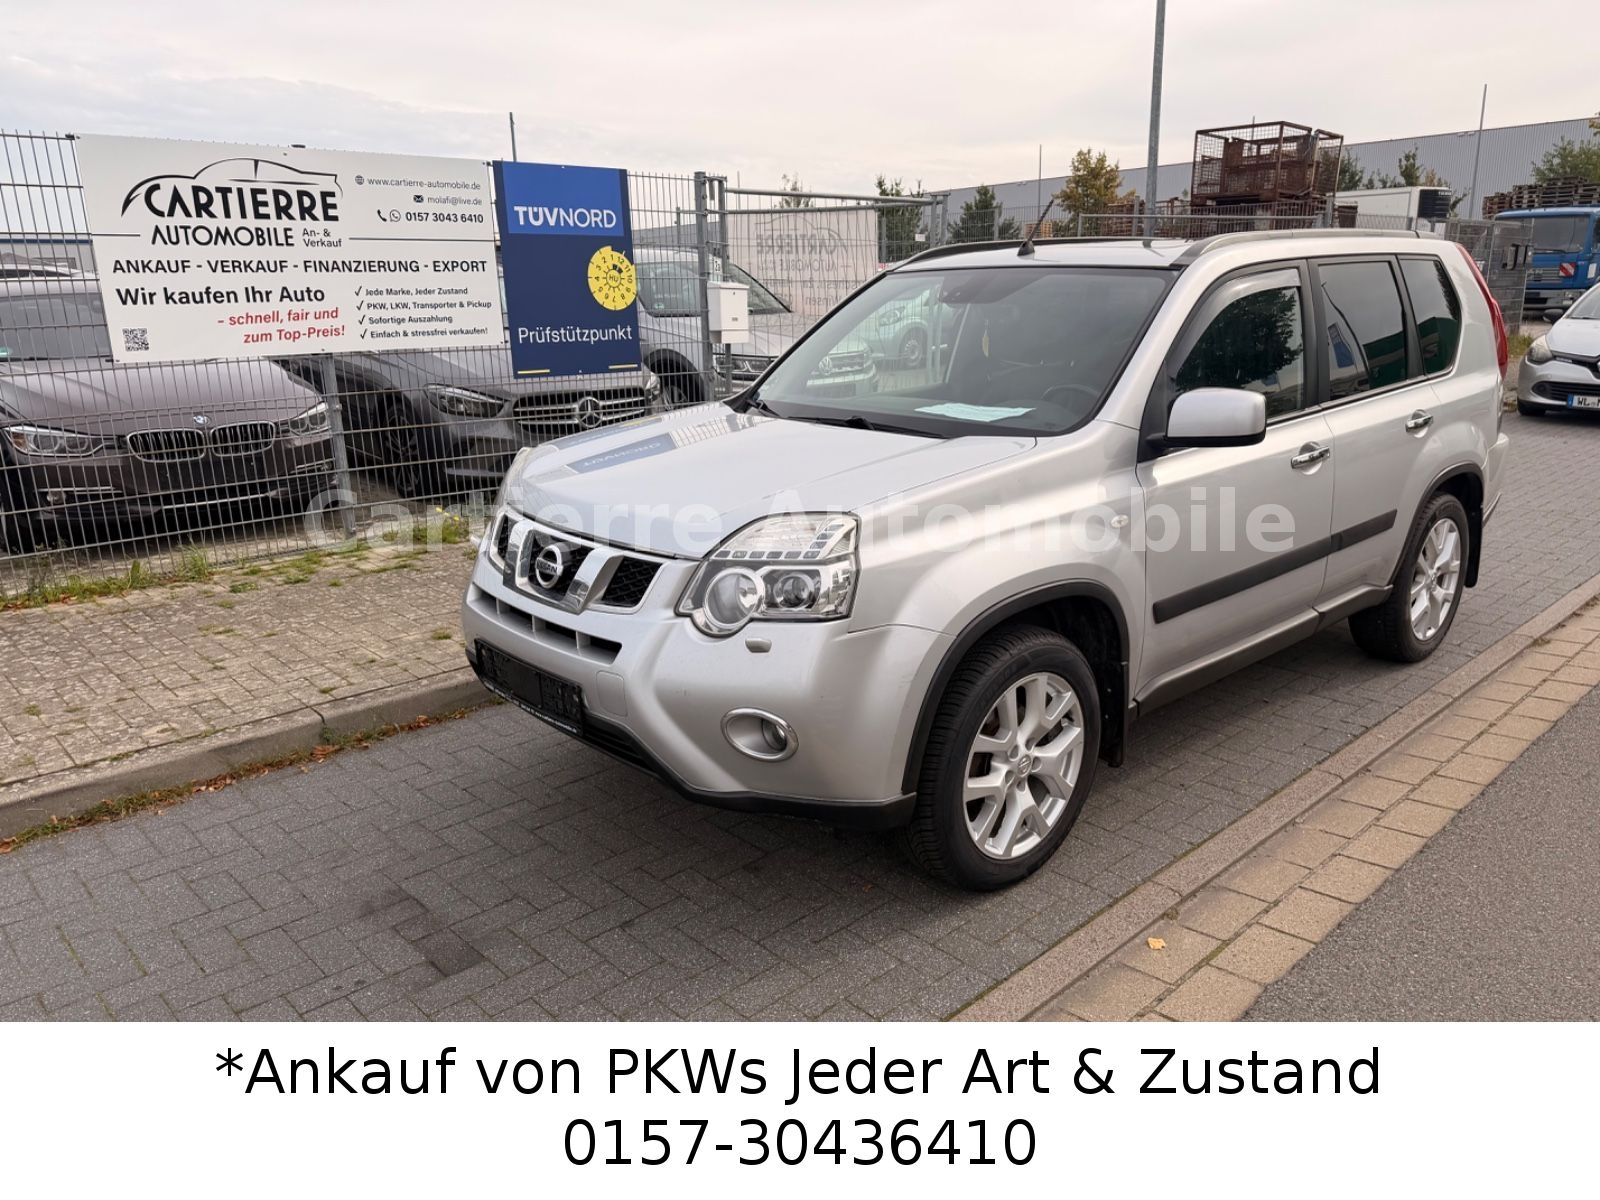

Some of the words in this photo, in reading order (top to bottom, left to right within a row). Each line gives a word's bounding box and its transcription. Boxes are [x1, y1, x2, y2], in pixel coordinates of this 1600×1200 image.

[367, 178, 481, 190] www.cartierre-automobile.de
[144, 183, 339, 222] CARTIERRE
[405, 212, 430, 222] 0157
[432, 212, 458, 223] 3043
[460, 213, 484, 223] 6410
[151, 224, 295, 247] AUTOMOBILE
[302, 228, 320, 238] An-
[323, 228, 331, 238] &
[303, 238, 342, 248] Verkauf
[112, 259, 191, 274] ANKAUF
[206, 259, 289, 273] VERKAUF
[303, 259, 420, 273] FINANZIERUNG
[432, 260, 488, 273] EXPORT
[116, 287, 157, 306] Wir
[163, 286, 238, 305] kaufen
[244, 286, 273, 303] Ihr
[279, 286, 326, 302] Auto
[365, 288, 384, 296] Jede
[386, 288, 413, 297] Marke,
[415, 288, 436, 296] Jeder
[437, 287, 468, 295] Zustand
[367, 302, 389, 311] PKW,
[390, 301, 411, 310] LKW,
[412, 301, 458, 310] Transporter
[467, 300, 492, 309] Pickup
[229, 310, 284, 326] schnell,
[287, 307, 311, 322] fair
[314, 307, 339, 320] und
[368, 316, 406, 325] Sofortige
[408, 315, 453, 324] Auszahlung
[243, 332, 272, 344] zum
[276, 325, 345, 343] Top-Preis!
[370, 330, 401, 339] Einfach
[411, 328, 447, 337] stressfrei
[448, 327, 489, 336] verkaufen!
[518, 324, 633, 345] Prüfstützpunkt
